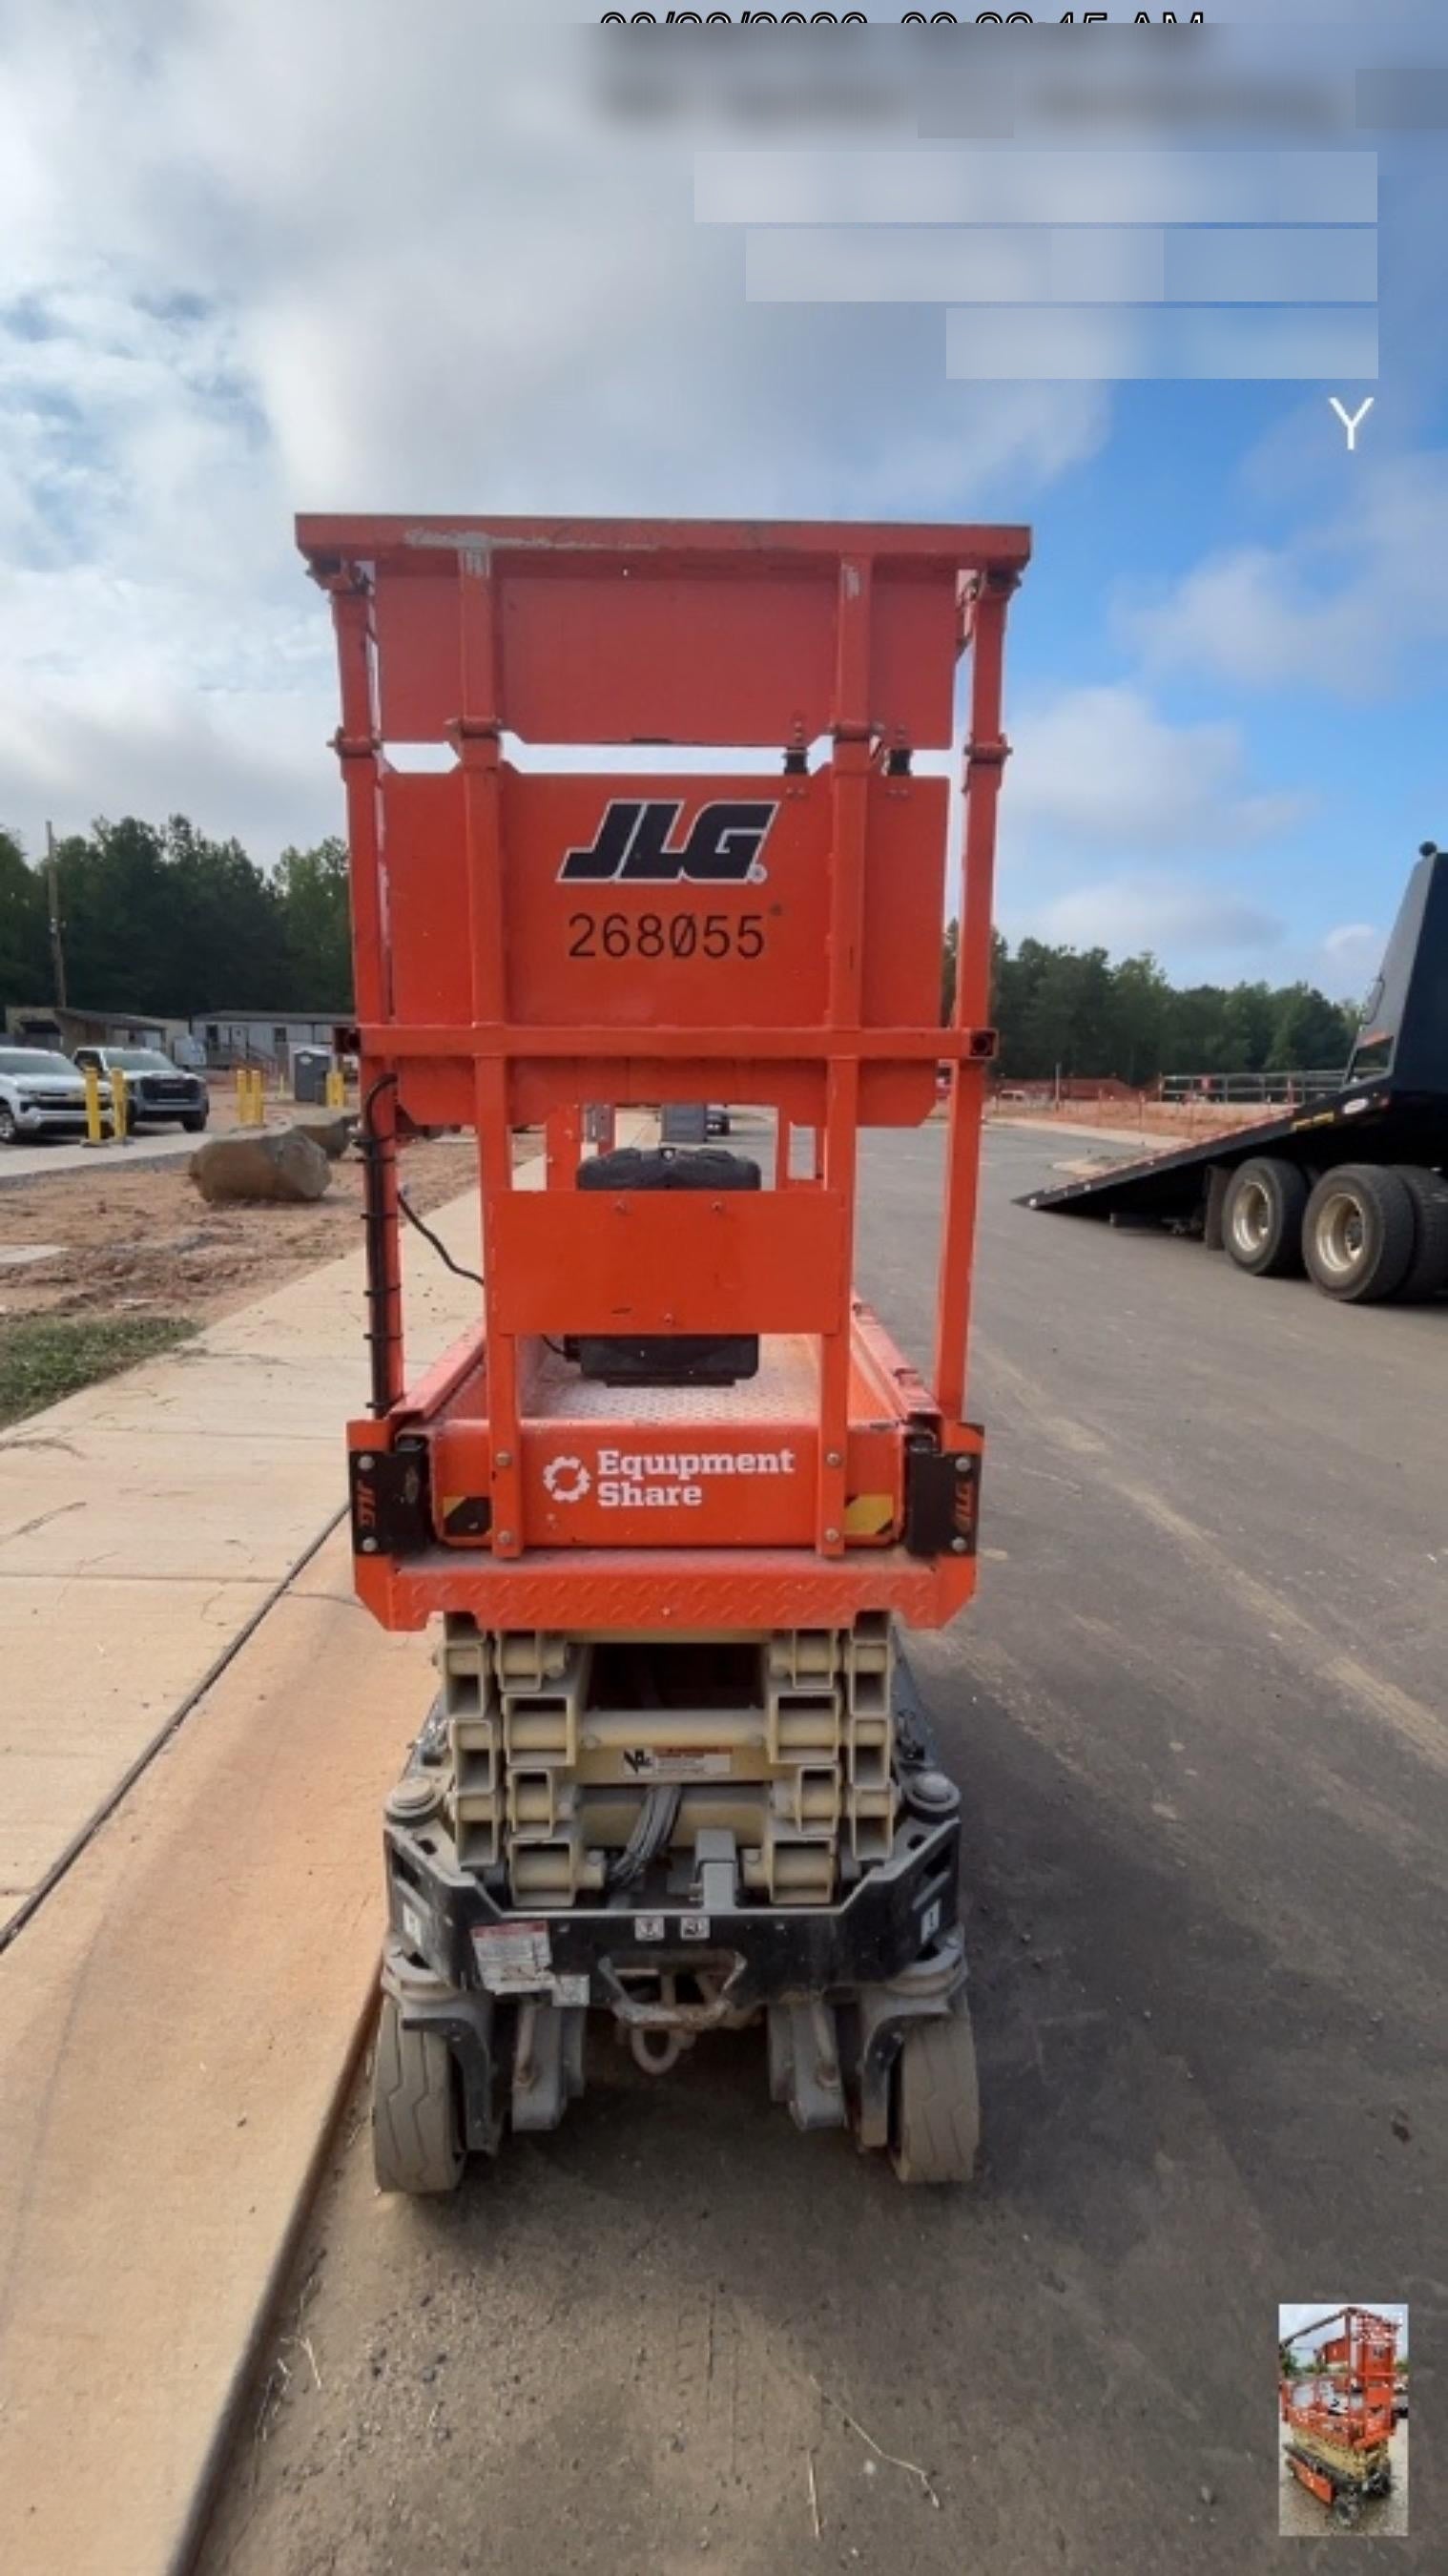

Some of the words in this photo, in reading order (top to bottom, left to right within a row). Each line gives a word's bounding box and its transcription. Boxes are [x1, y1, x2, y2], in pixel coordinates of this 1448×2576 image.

[555, 799, 780, 883] JLG
[569, 912, 765, 960] 268055
[597, 1448, 796, 1480] Equipment
[597, 1481, 703, 1507] Share
